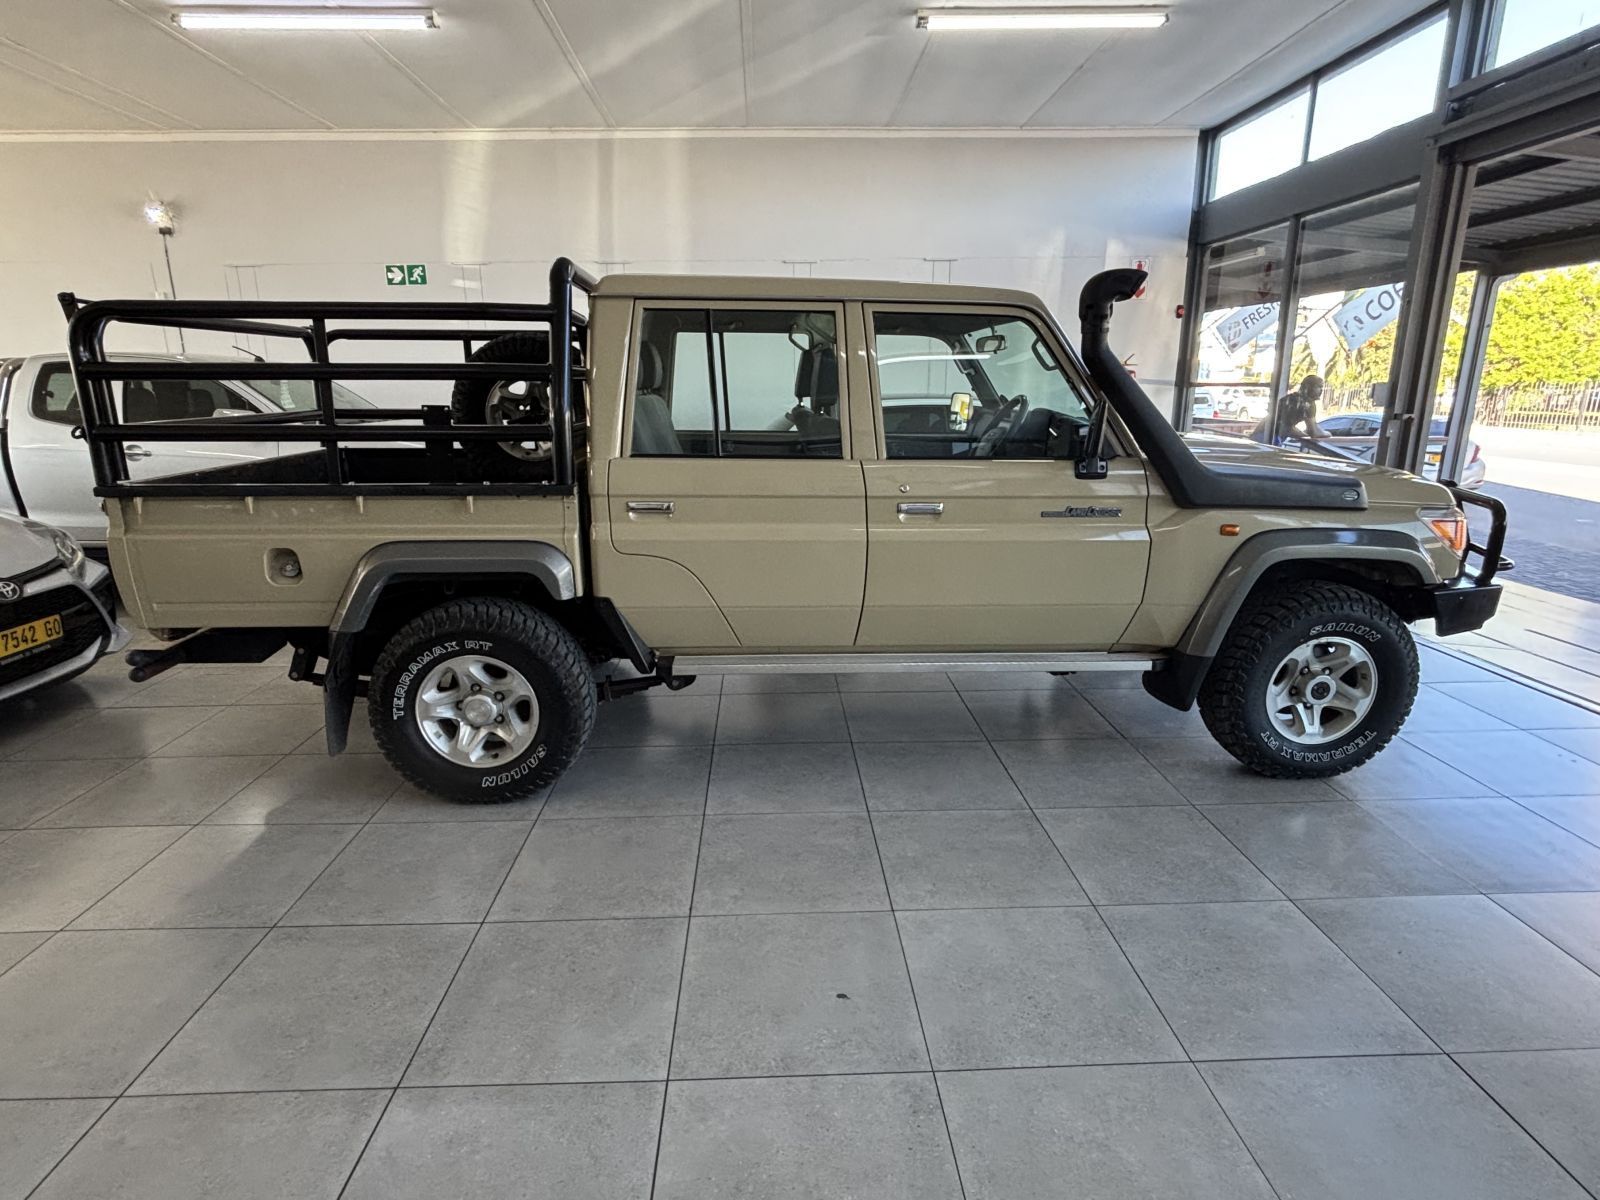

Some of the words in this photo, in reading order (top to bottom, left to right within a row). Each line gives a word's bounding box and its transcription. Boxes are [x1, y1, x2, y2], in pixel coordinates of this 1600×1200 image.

[1, 625, 38, 652] 7542
[1310, 622, 1381, 642] SAILUN
[392, 641, 460, 720] TERRAMAX
[465, 640, 493, 651] RT
[1260, 731, 1279, 750] RT
[1281, 730, 1377, 762] TERRAMAX
[482, 744, 547, 787] SAILUN
